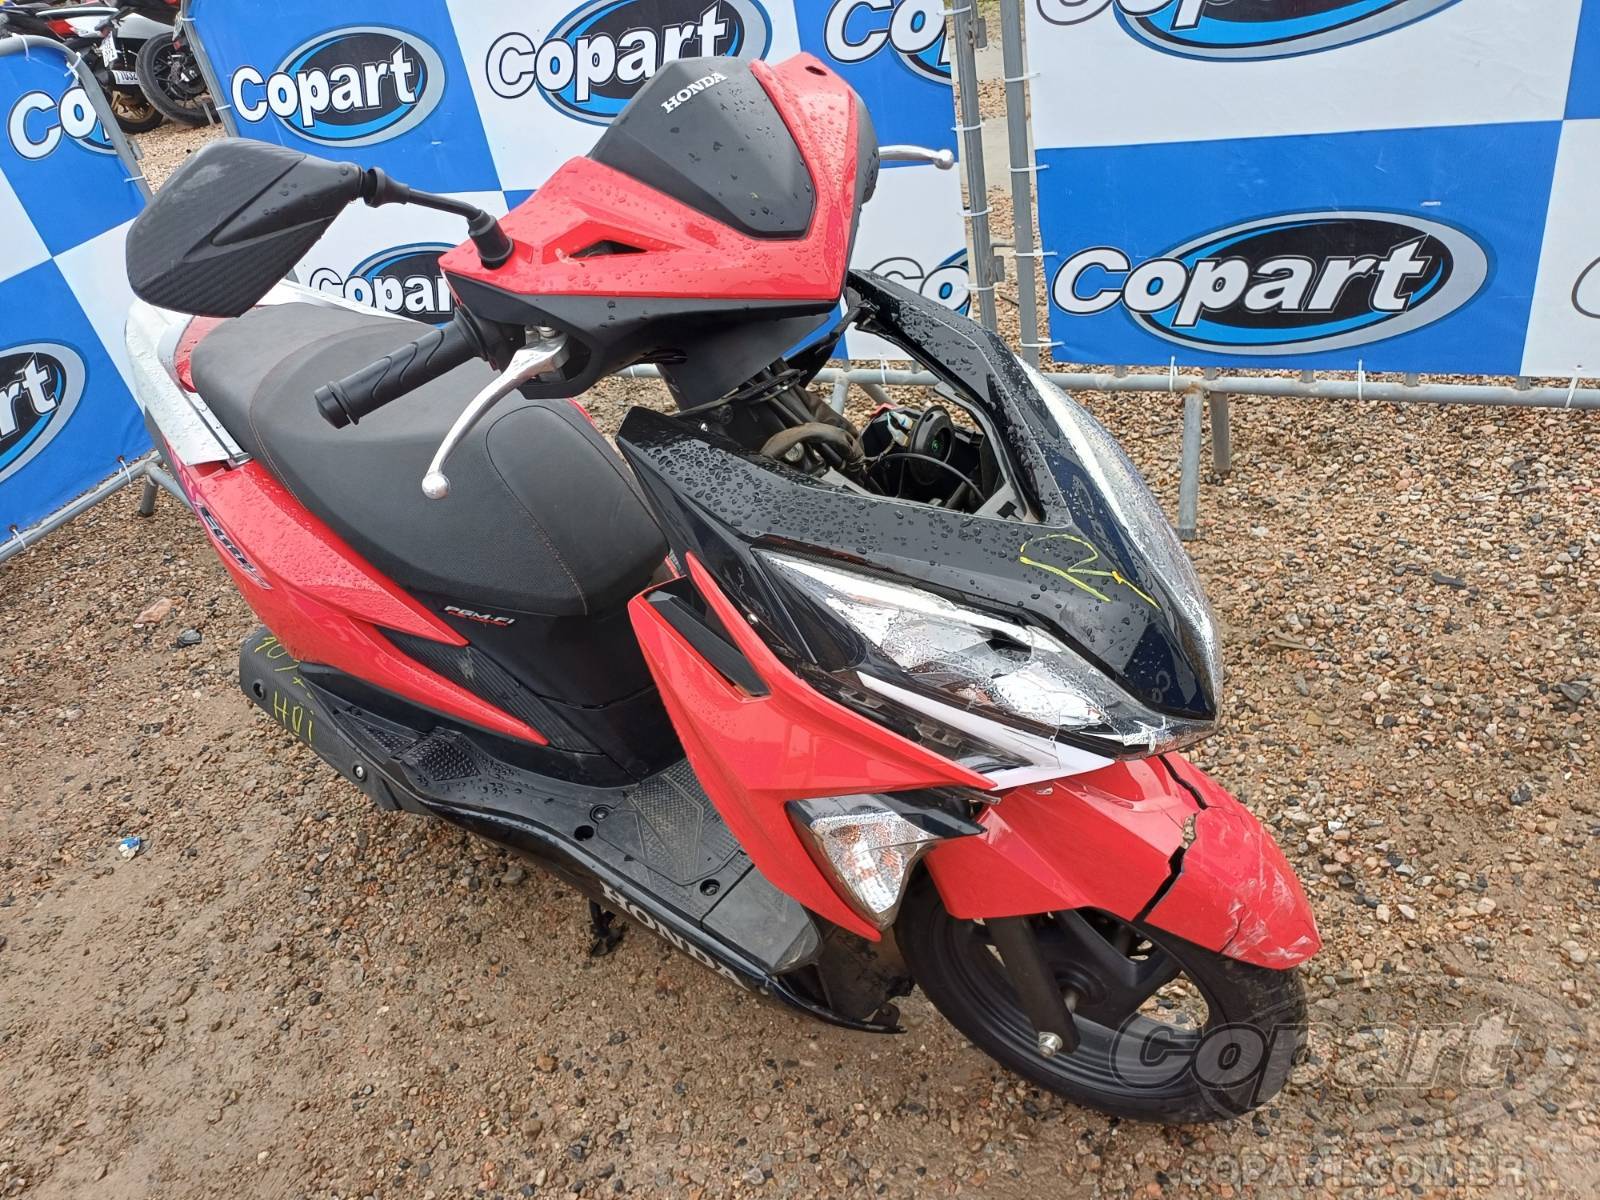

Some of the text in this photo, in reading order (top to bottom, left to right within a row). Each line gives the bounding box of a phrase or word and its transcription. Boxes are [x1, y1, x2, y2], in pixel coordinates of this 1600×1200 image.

[232, 41, 417, 128] Copart
[485, 2, 729, 102] Copart
[661, 72, 728, 114] HONDA
[1053, 233, 1430, 328] Copart
[600, 880, 751, 992] HONDA
